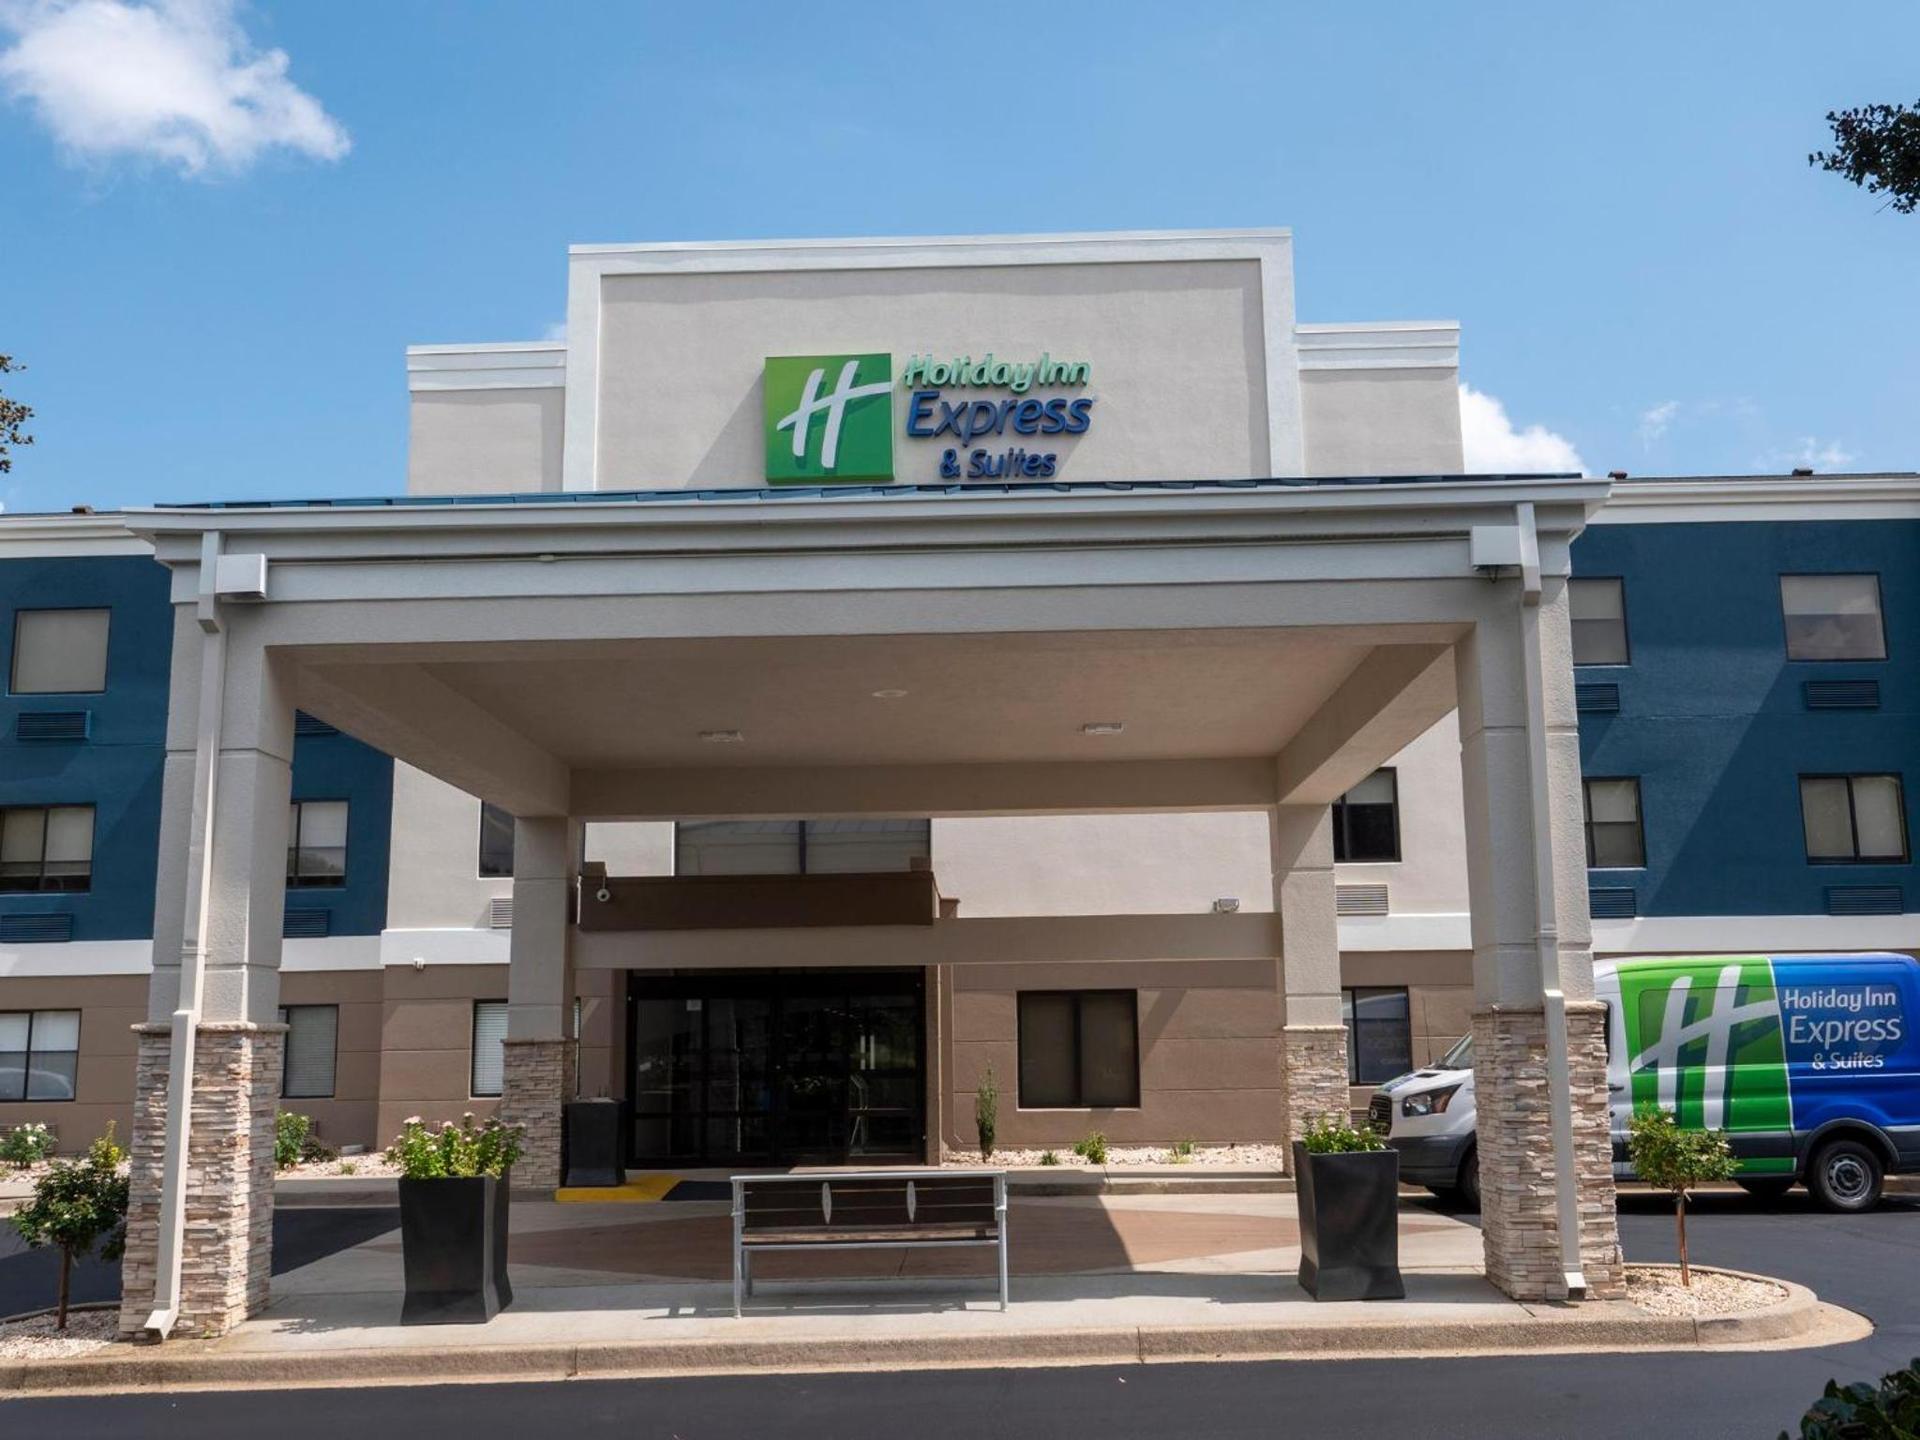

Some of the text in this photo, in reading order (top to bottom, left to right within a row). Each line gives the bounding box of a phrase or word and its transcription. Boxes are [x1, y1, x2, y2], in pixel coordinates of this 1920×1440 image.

[904, 352, 1091, 394] Holiday Inn
[906, 390, 1093, 448] Express
[939, 447, 1057, 479] & Suites
[1784, 986, 1896, 1012] Holiday Inn
[1789, 1015, 1902, 1050] Express
[1811, 1051, 1884, 1070] & Suites
